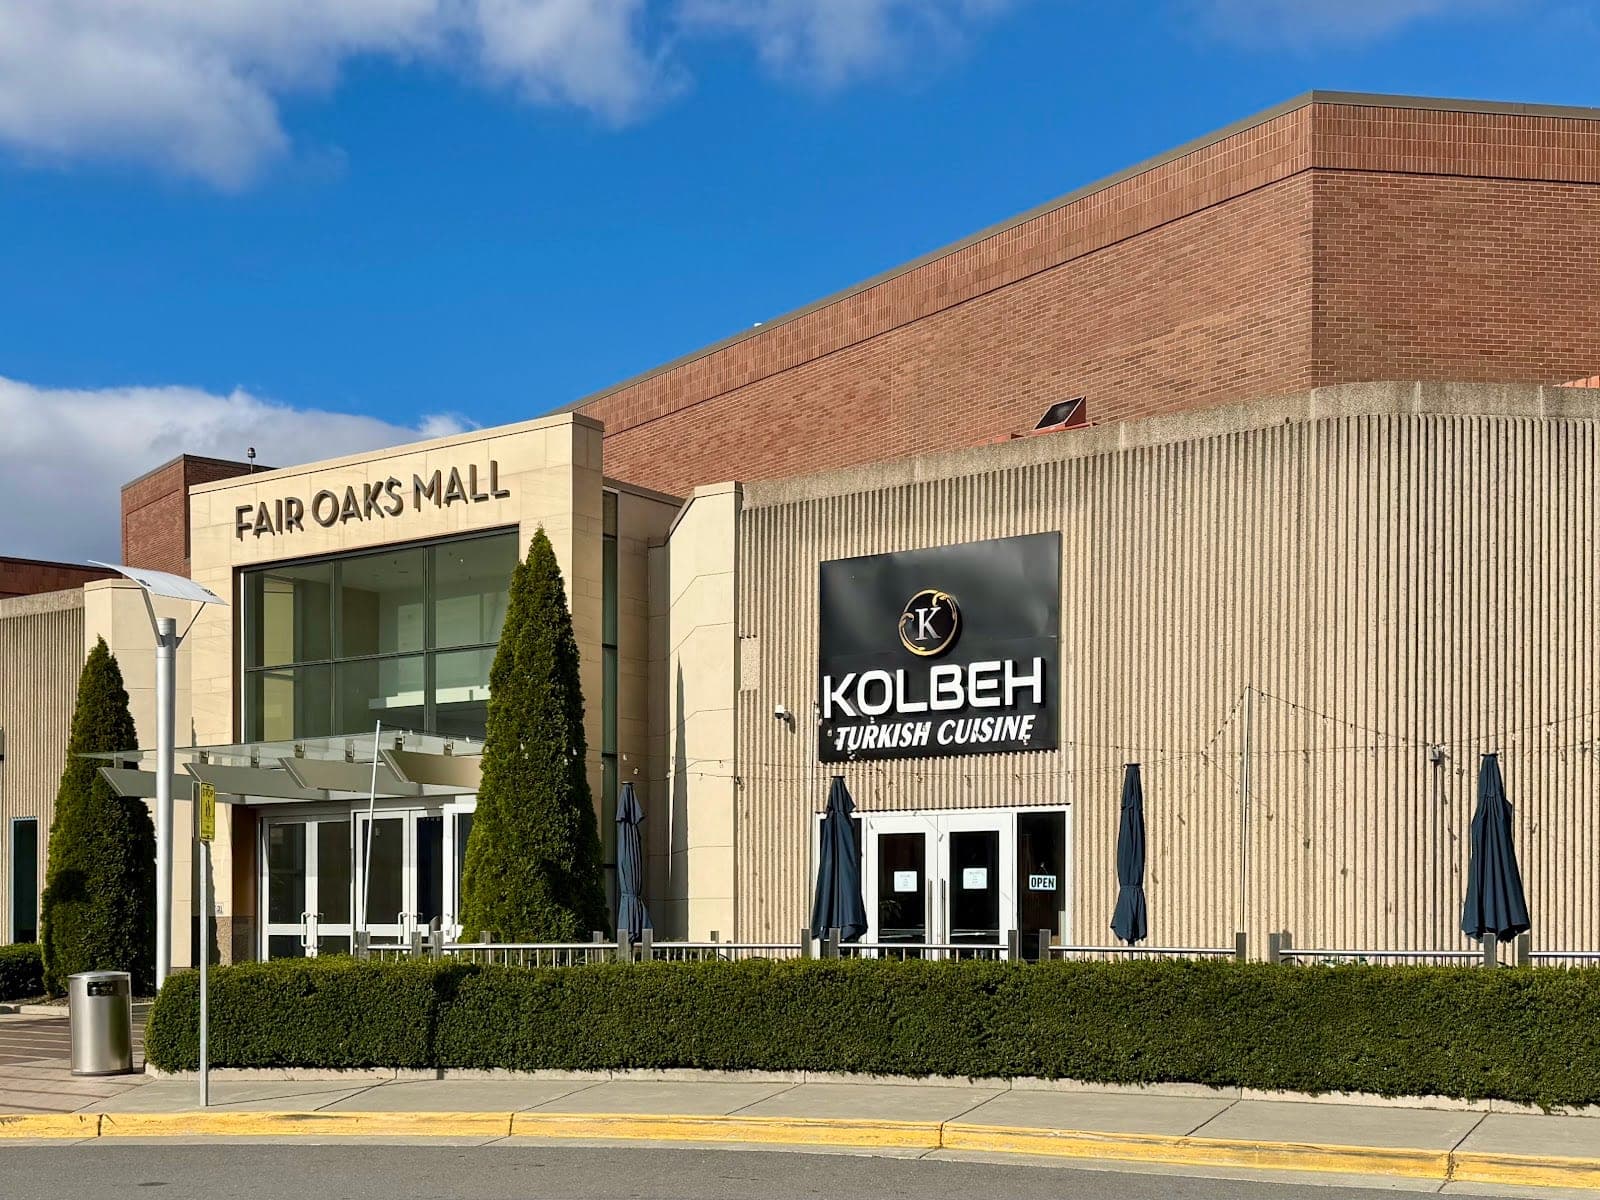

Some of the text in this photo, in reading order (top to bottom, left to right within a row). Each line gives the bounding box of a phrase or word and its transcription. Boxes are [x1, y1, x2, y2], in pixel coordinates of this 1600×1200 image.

[235, 460, 510, 541] FAIR OAKS MALL
[914, 606, 942, 641] K
[823, 657, 1042, 719] KOLBEH
[836, 714, 1036, 752] TURKISH CUISINE
[1031, 877, 1055, 888] OPEN
